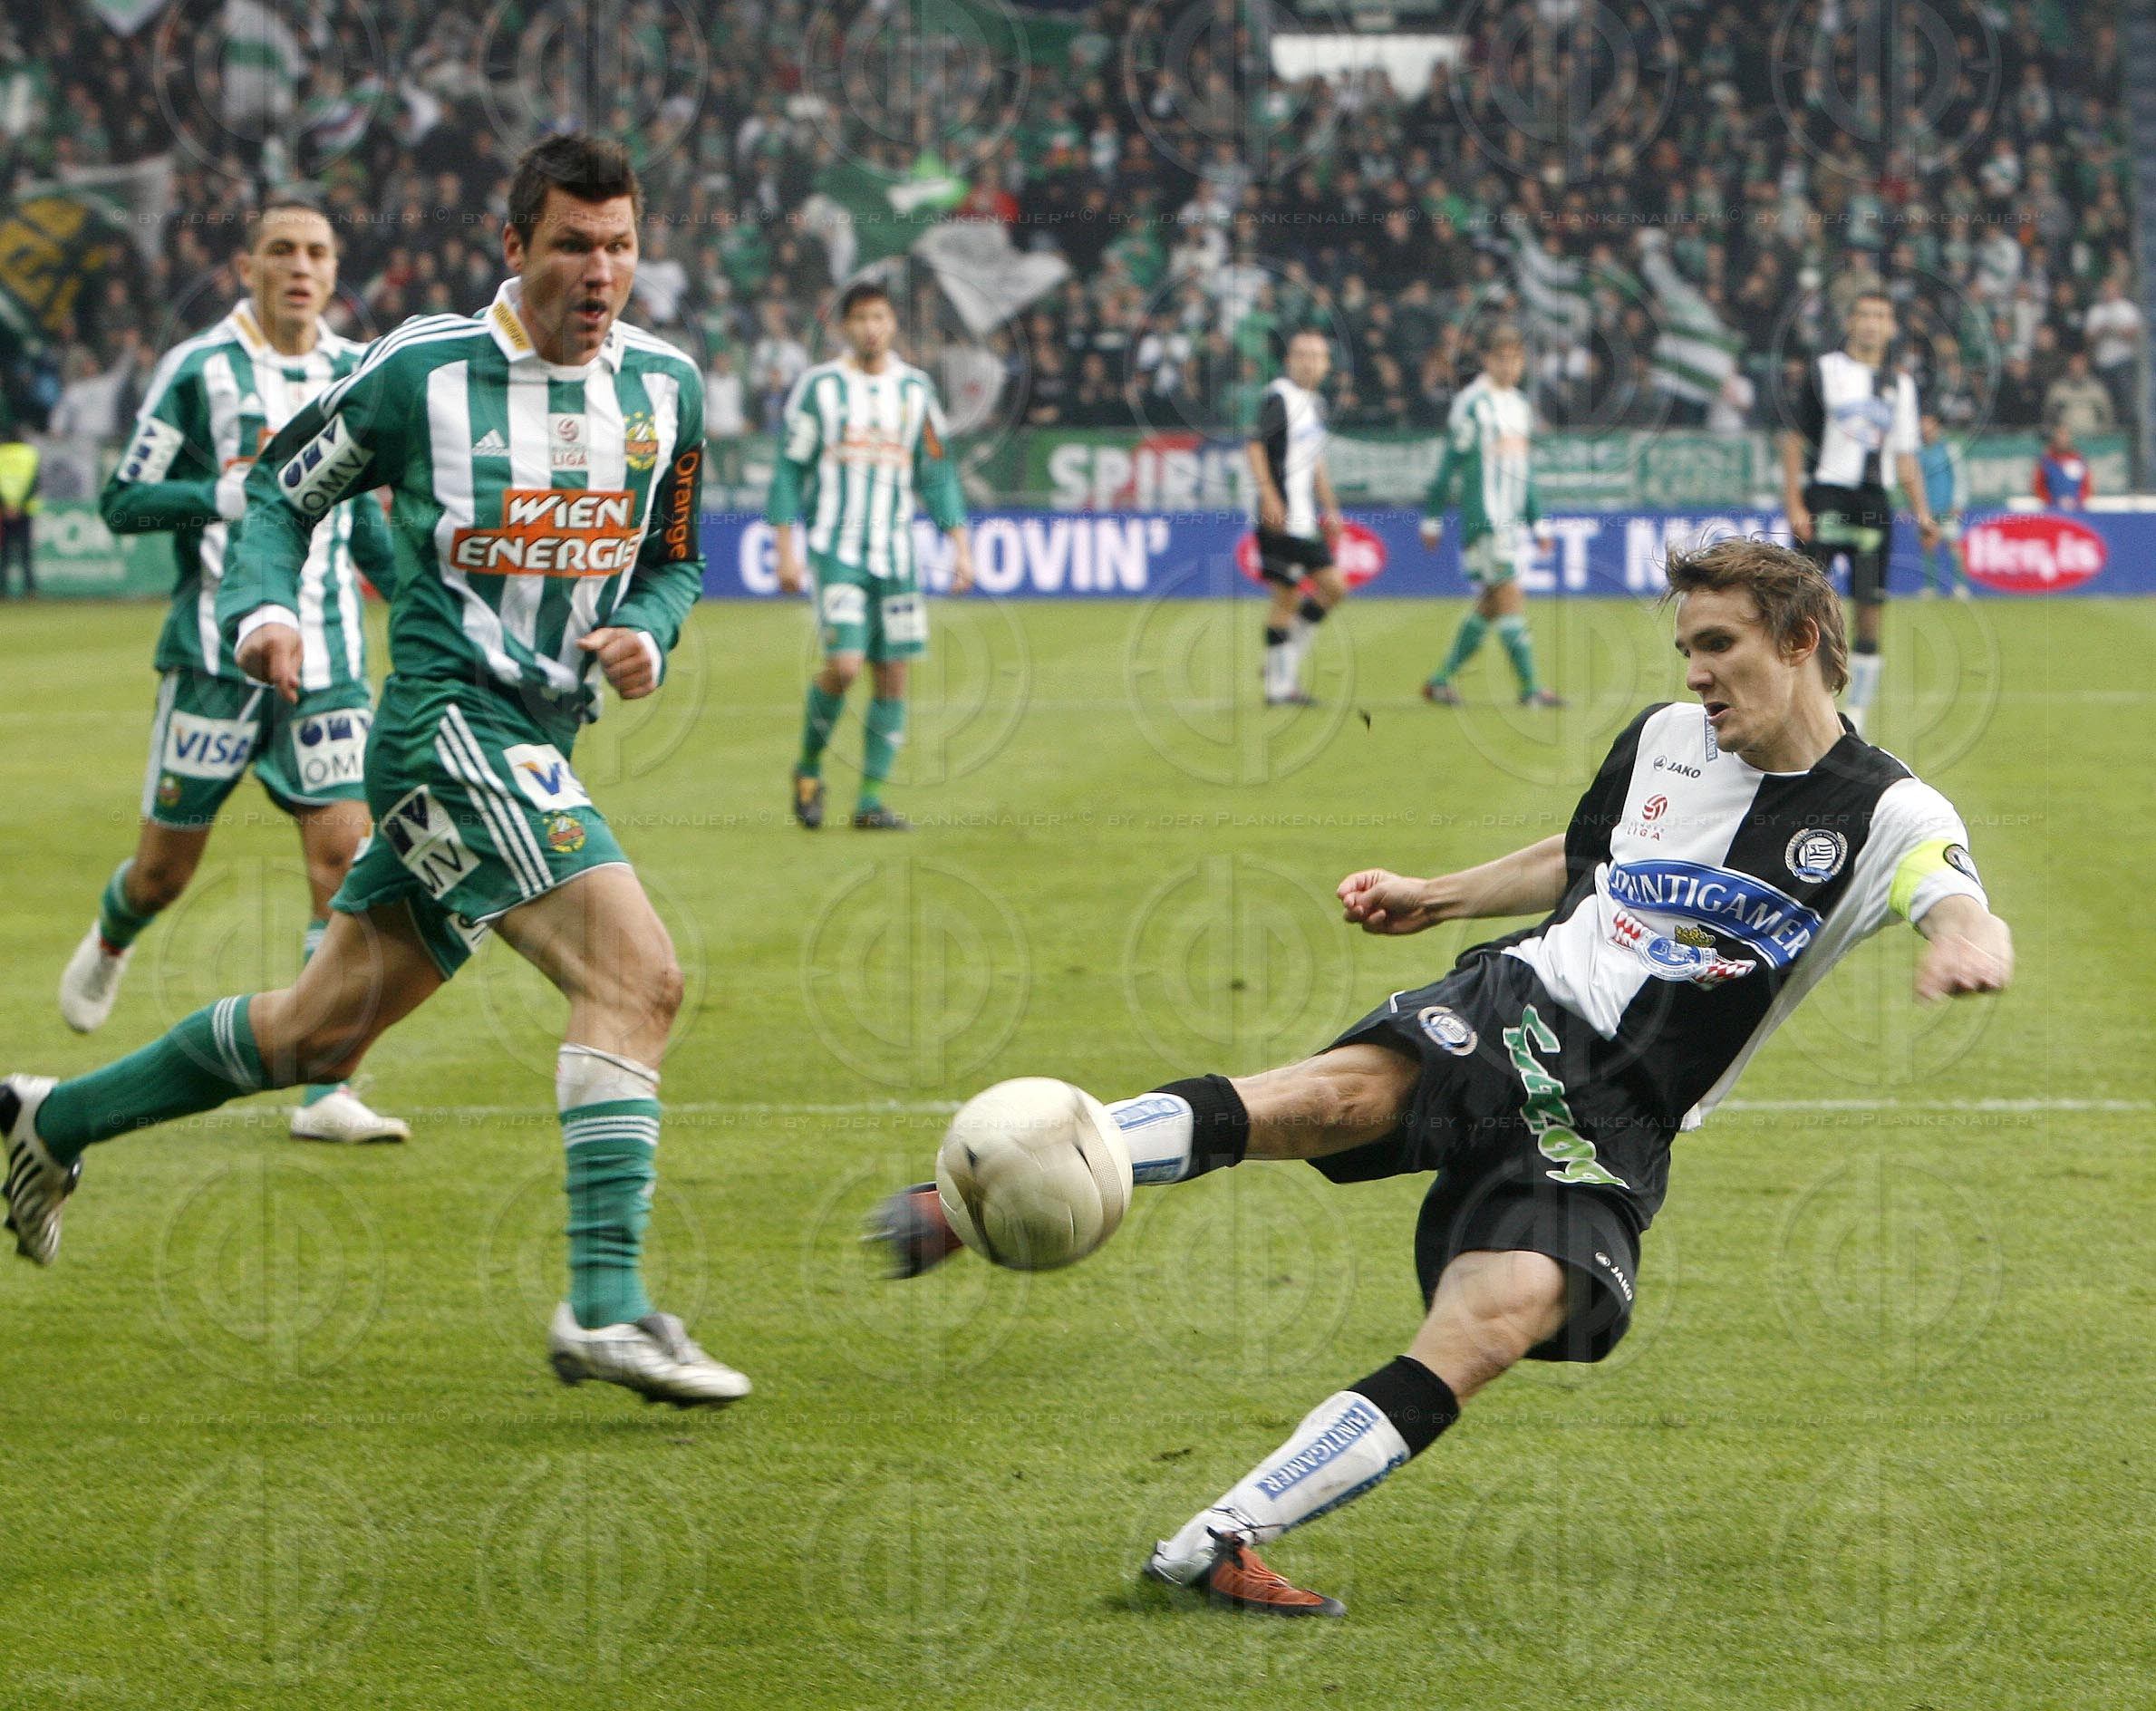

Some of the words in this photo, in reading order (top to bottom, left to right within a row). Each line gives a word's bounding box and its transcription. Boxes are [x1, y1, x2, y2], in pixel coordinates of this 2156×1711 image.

[552, 453, 587, 467] LIGA
[302, 450, 363, 512] OMV
[508, 494, 630, 529] WIEN
[666, 451, 700, 559] Orange
[176, 729, 250, 766] VISA
[305, 752, 364, 785] OM
[1668, 761, 1701, 779] JAKO
[1627, 826, 1661, 842] LIGA
